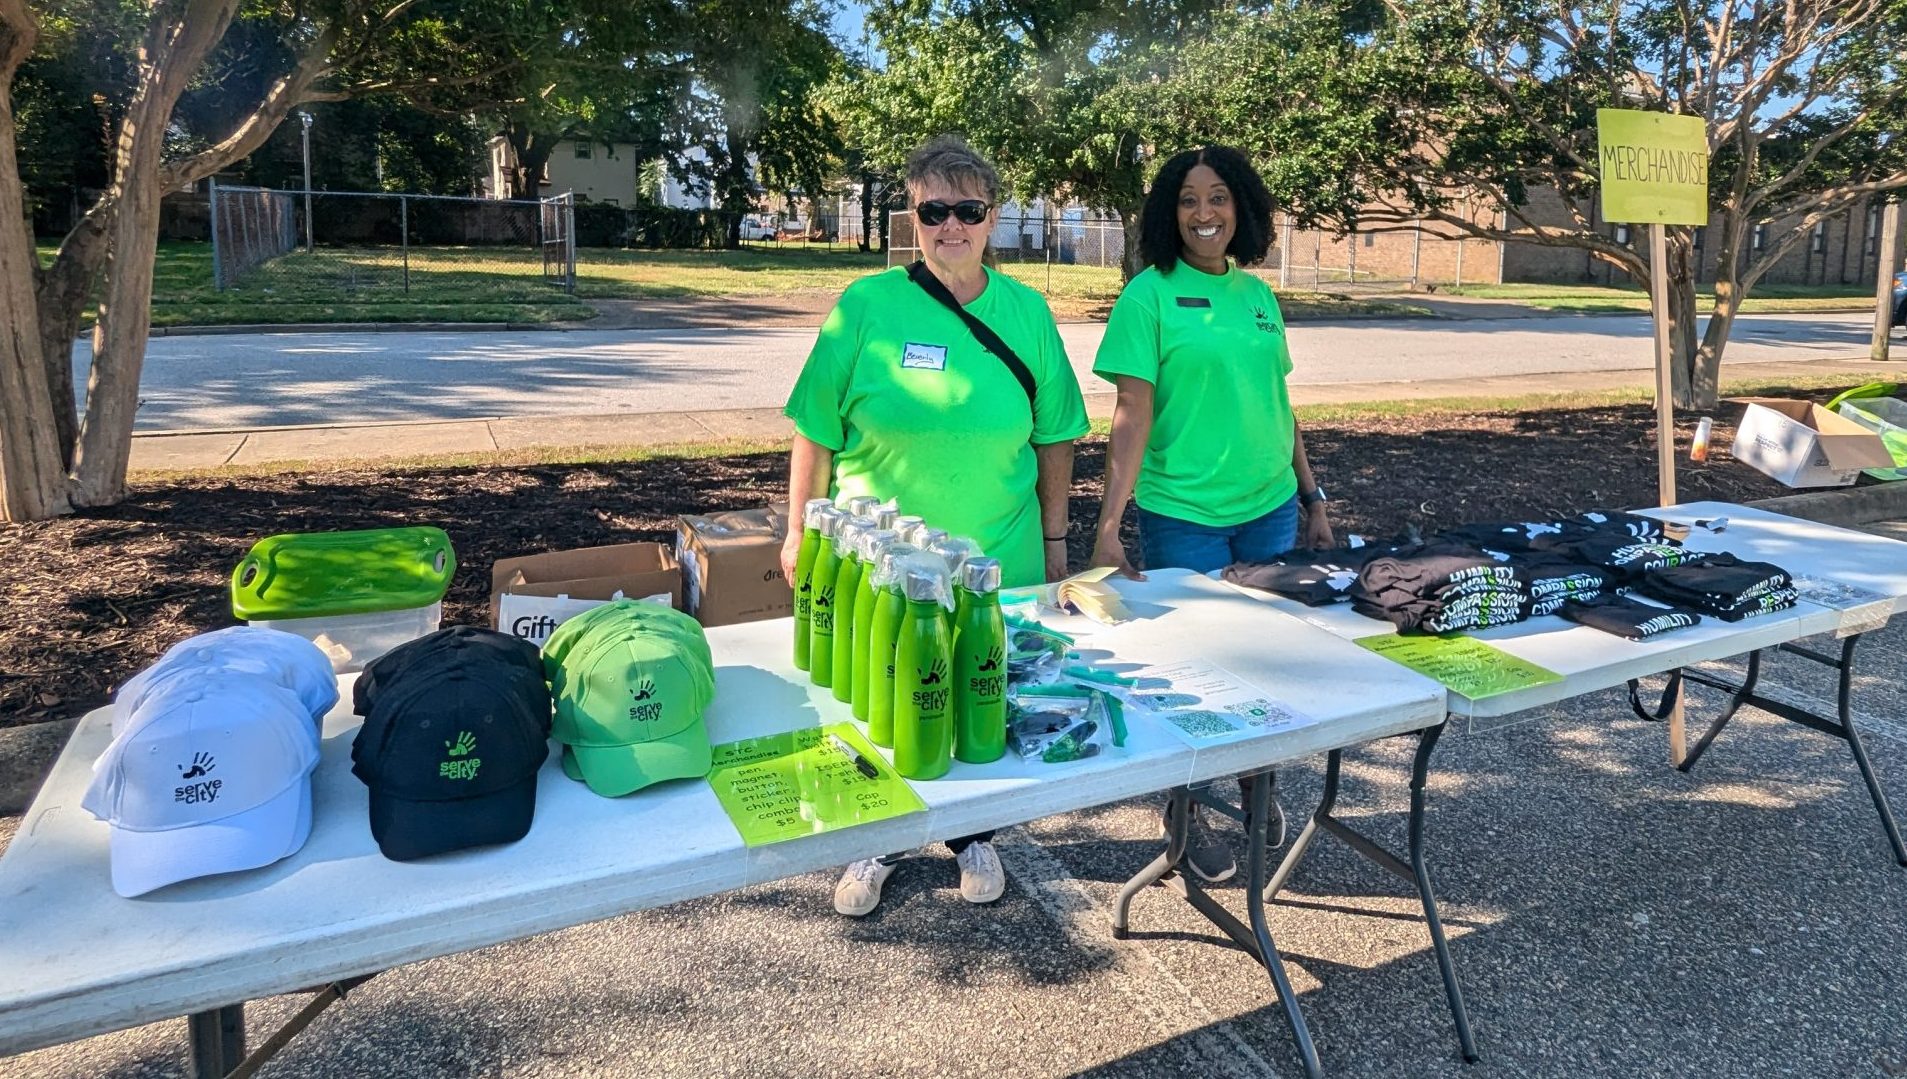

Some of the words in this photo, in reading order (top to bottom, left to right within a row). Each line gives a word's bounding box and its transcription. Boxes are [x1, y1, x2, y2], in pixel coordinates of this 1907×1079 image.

[1602, 145, 1706, 185] MERCHANDISE
[1531, 577, 1602, 599] OMPASSION
[1635, 612, 1693, 635] HUMILITY
[969, 673, 1005, 688] serve
[912, 687, 949, 702] serve
[629, 702, 662, 716] serve
[440, 758, 481, 771] serve
[174, 779, 222, 797] serve
[856, 792, 880, 802] Cap
[745, 800, 774, 812] chip
[860, 800, 889, 811] $20
[775, 817, 796, 827] $5
